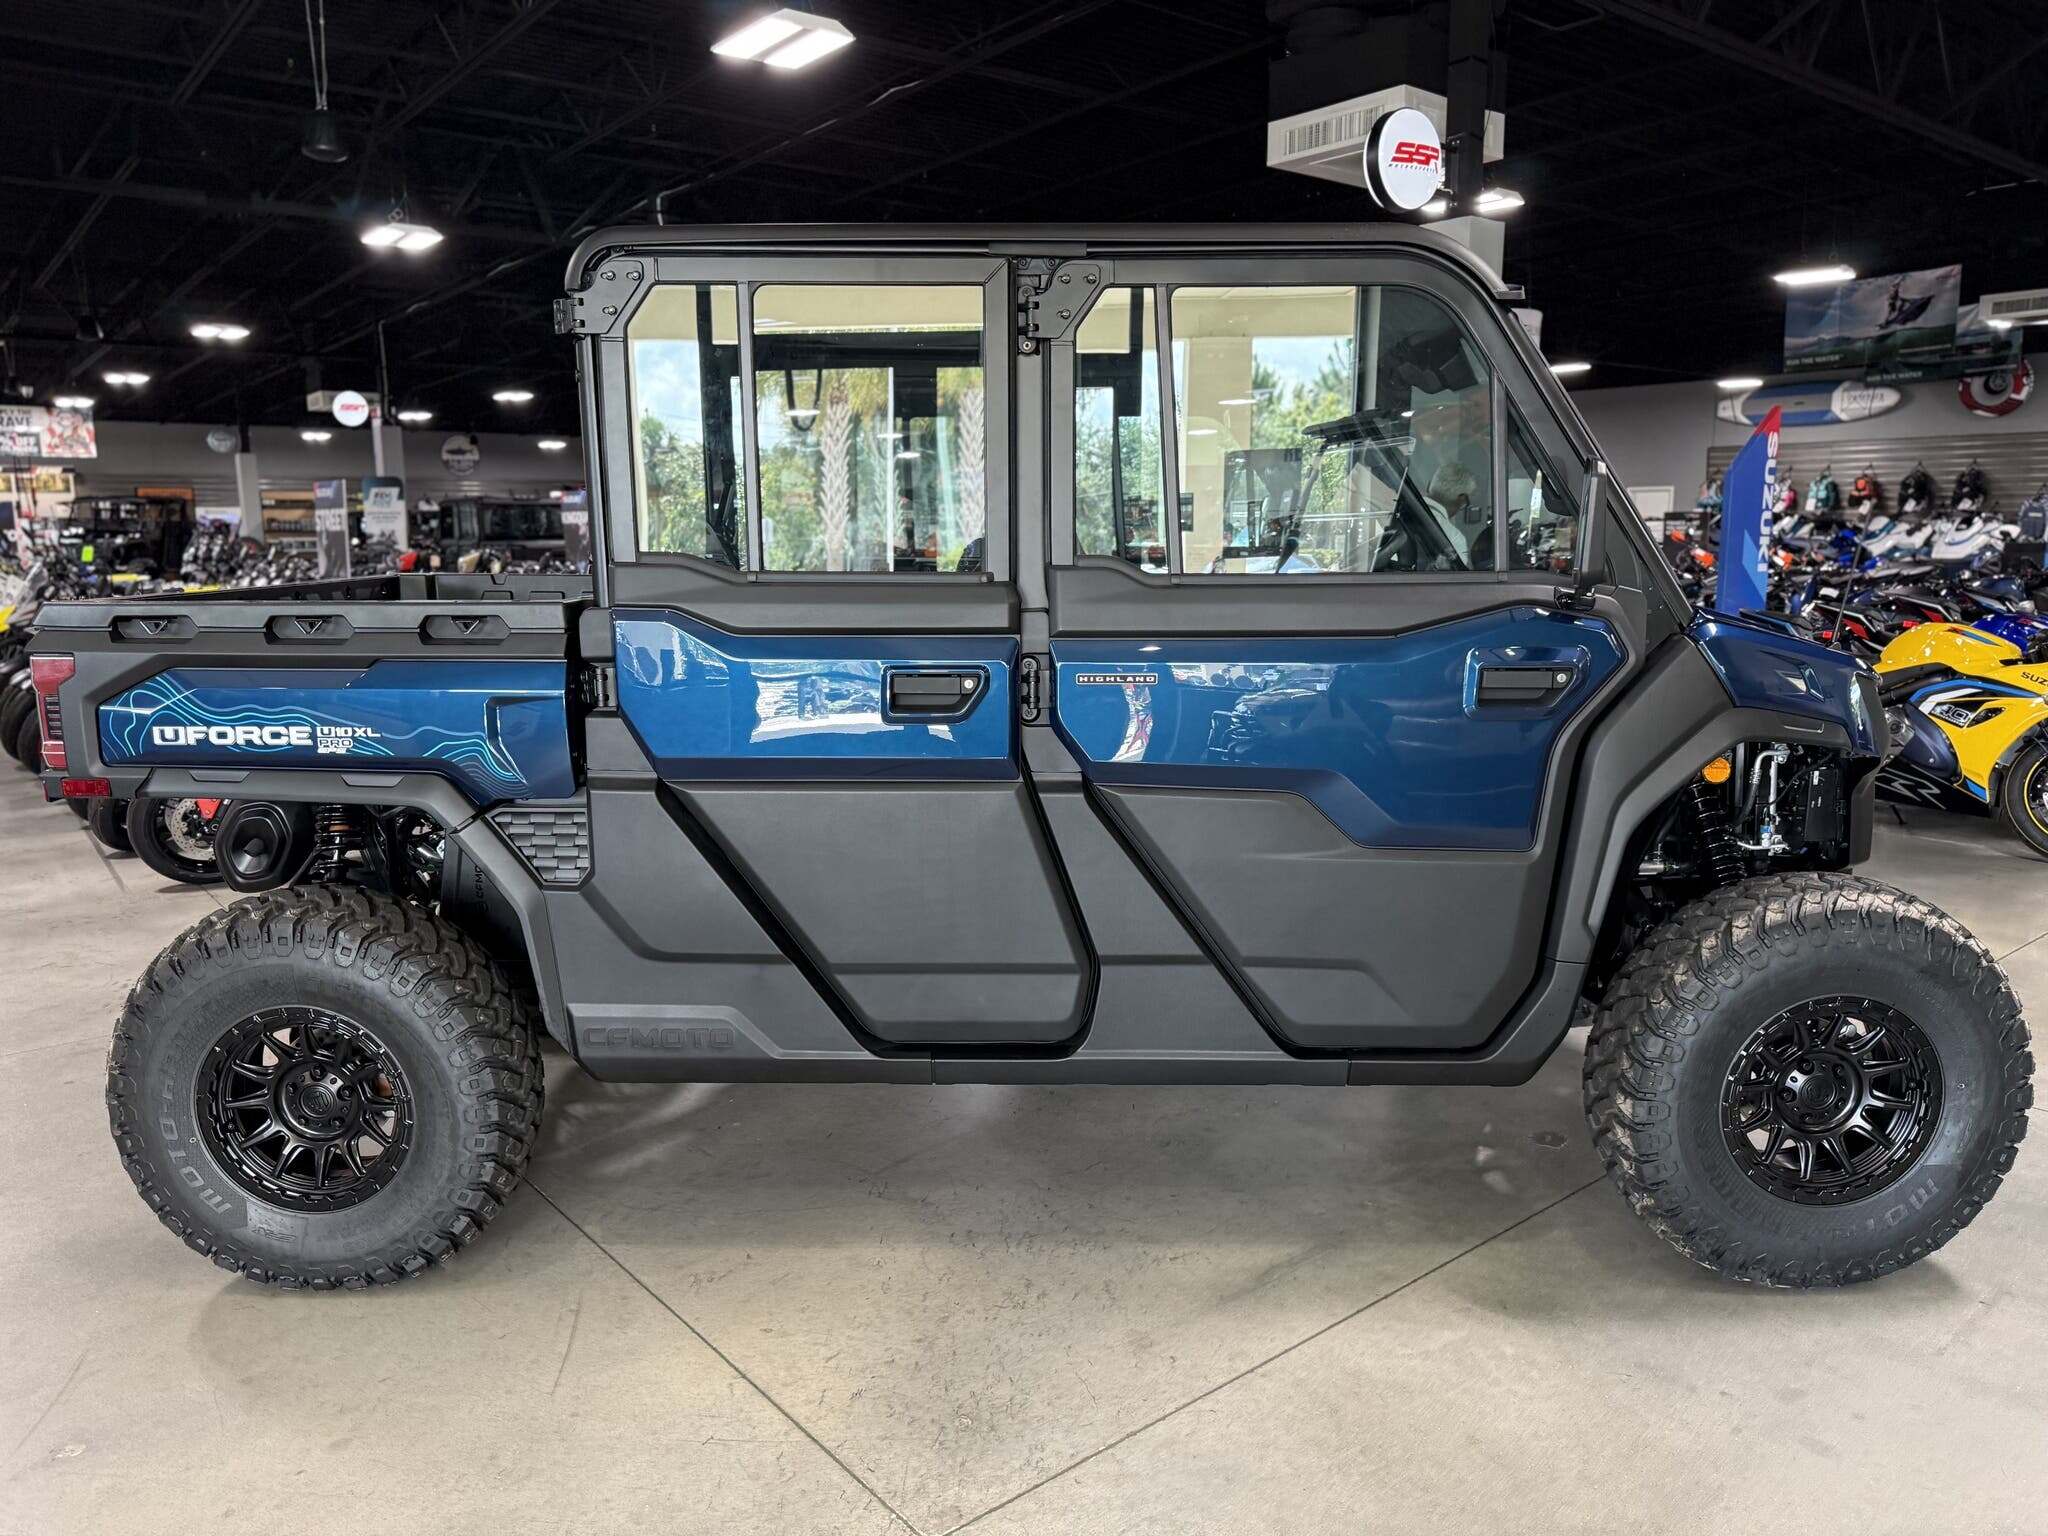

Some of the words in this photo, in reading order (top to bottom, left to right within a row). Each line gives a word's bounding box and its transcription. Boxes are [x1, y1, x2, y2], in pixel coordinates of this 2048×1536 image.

[152, 726, 313, 746] UFORCE
[318, 737, 354, 748] PRO
[582, 1027, 735, 1049] CFMOTO
